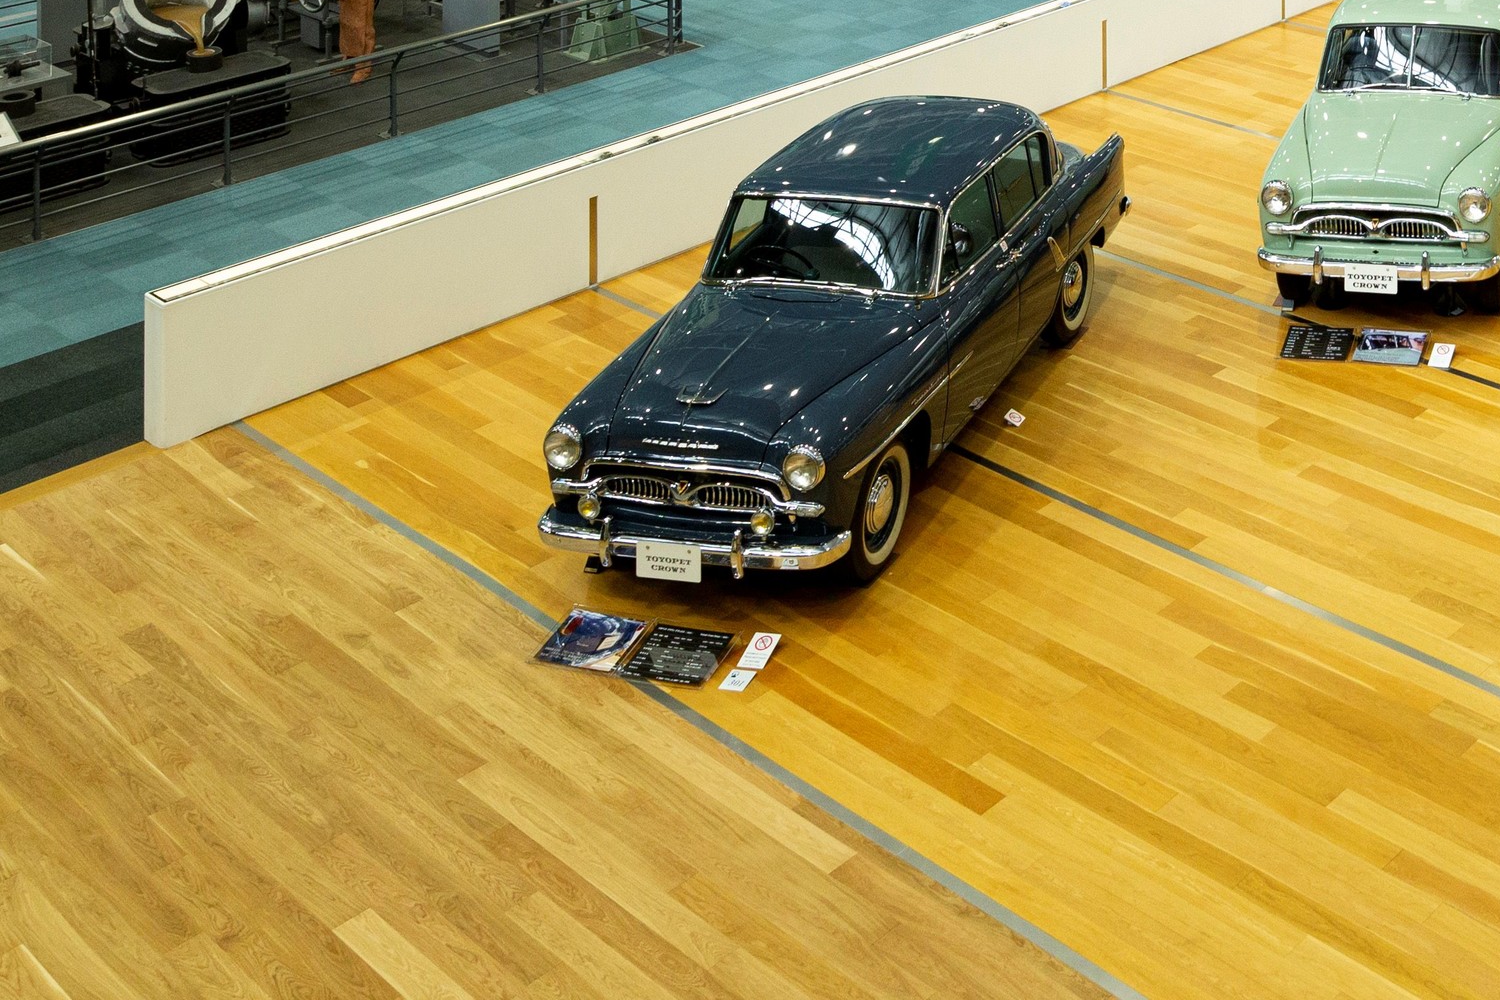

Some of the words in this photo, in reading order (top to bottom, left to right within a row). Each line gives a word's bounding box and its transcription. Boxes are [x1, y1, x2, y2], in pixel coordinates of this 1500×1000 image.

[1347, 273, 1394, 282] TOYOPET
[1352, 282, 1388, 290] CROWN
[645, 555, 692, 566] TOYOPET
[651, 564, 687, 573] CROWN
